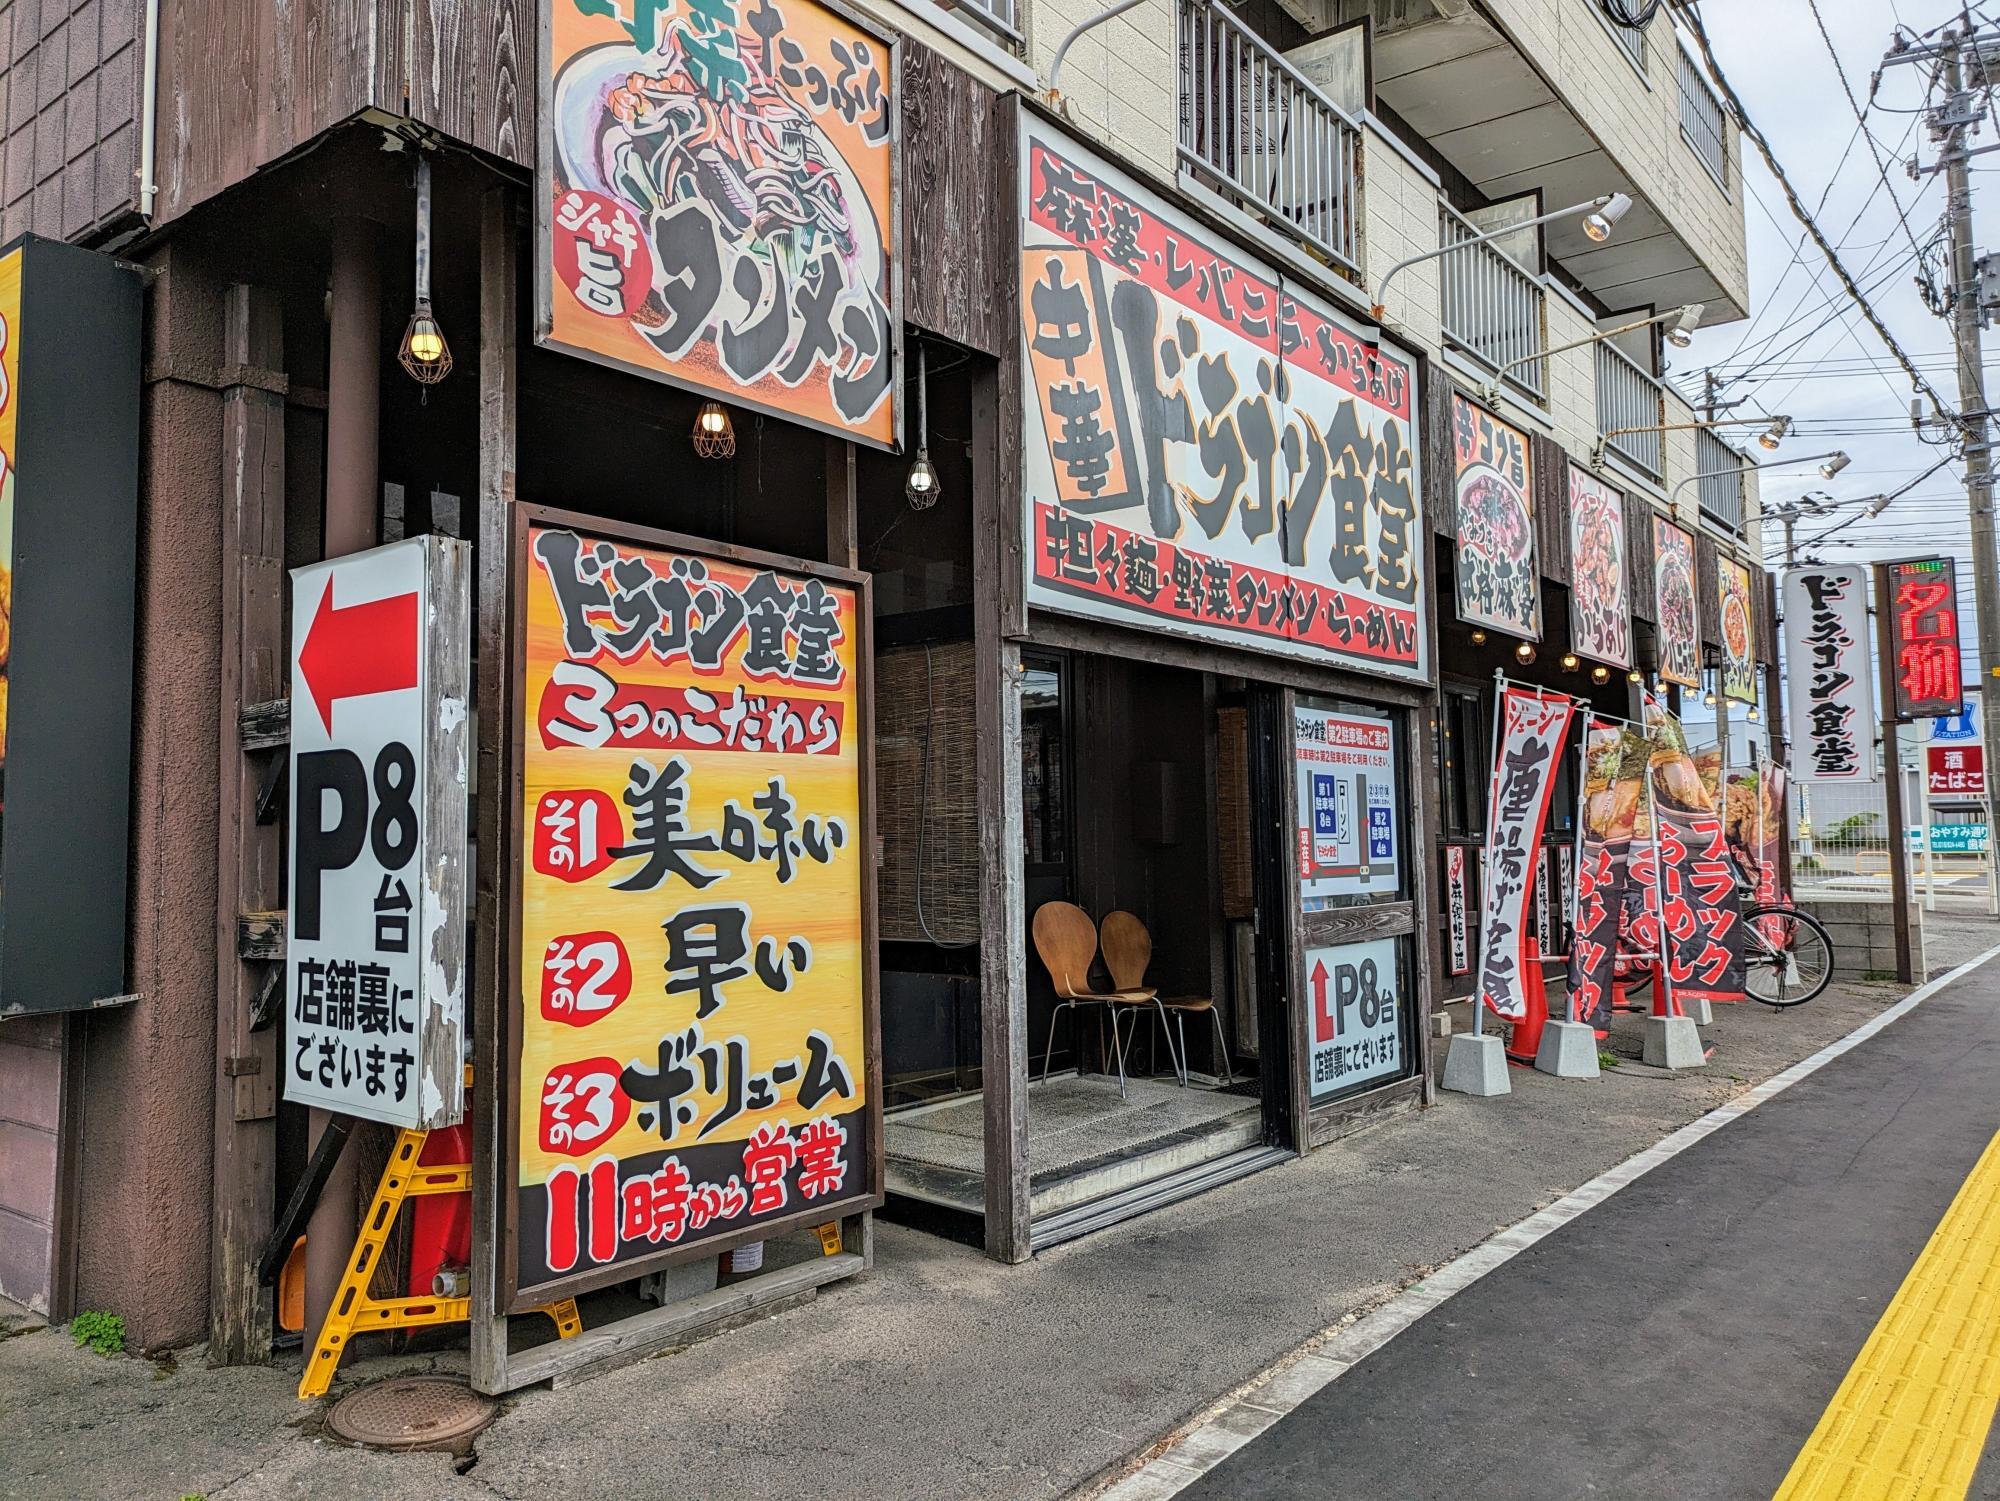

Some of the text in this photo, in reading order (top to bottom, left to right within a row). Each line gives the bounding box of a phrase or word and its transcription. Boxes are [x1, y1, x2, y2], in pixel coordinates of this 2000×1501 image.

[557, 194, 640, 268] シャキ
[637, 206, 891, 424] タンメン
[1030, 256, 1116, 496] 中華
[1111, 279, 1420, 605] ドラゴン食堂
[534, 530, 843, 684] ドラゴン食堂
[1896, 580, 1958, 701] 名物
[547, 661, 838, 755] 3つのこだわり
[1801, 573, 1859, 778] ドラゴン食堂
[1328, 724, 1389, 748] 第2駐車場のご案内
[1508, 700, 1565, 738] ジューシー
[1929, 771, 1984, 790] たばこ
[1944, 751, 1963, 769] 酒
[541, 758, 848, 891] その1 美味い
[1319, 812, 1332, 828] 8台
[1339, 785, 1348, 840] ローソン
[1374, 811, 1387, 826] 第2
[1376, 841, 1387, 855] 4台
[1930, 826, 1987, 838] おやすみ通り
[1690, 819, 1735, 986] ブラック
[295, 957, 414, 1036] 店舗裏に
[543, 902, 812, 1020] その2 早い
[296, 1030, 414, 1103] ございます
[541, 1025, 856, 1149] その3 ボリューム
[1315, 1031, 1396, 1083] 店舗裏にございます
[546, 1115, 848, 1274] 11時から営業
